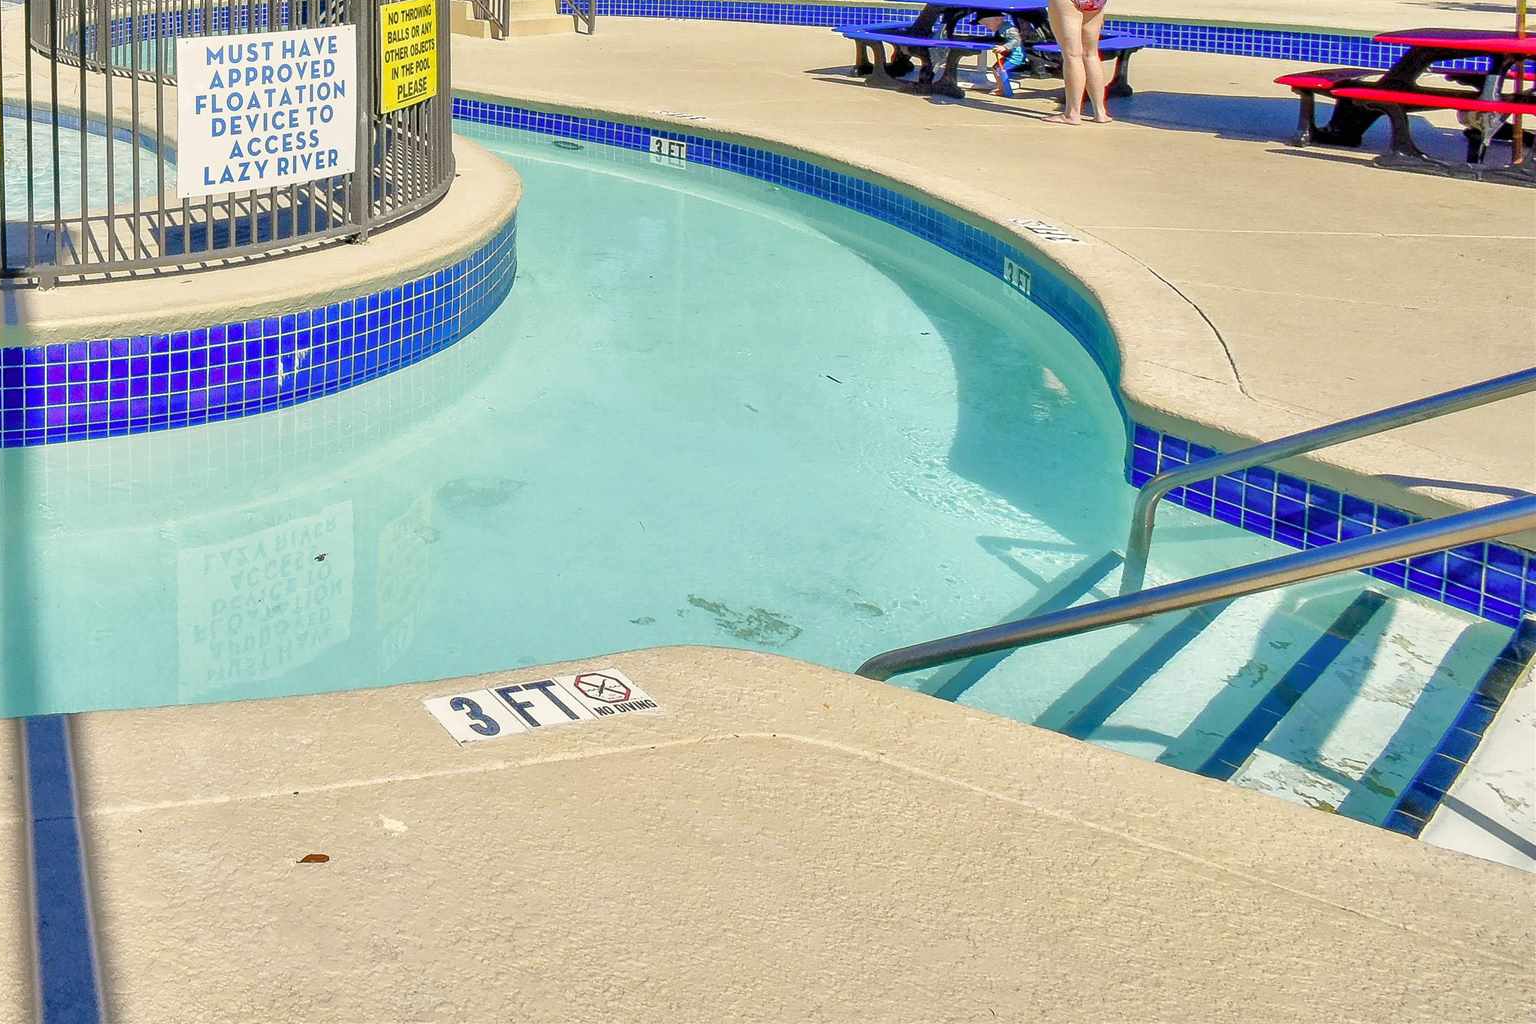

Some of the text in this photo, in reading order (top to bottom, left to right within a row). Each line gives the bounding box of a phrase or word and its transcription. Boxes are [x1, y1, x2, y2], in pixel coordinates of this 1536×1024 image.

[388, 4, 432, 25] NO THROWING
[387, 21, 433, 44] BALLS OR ANY
[206, 35, 338, 65] MUST HAVE
[385, 39, 435, 63] OTHER OBJECTS
[209, 59, 336, 89] APPROVED
[391, 58, 431, 80] IN THE POOL
[195, 80, 346, 115] FLOATATION
[397, 77, 427, 100] PLEASE
[211, 104, 334, 137] DEVICE TO
[229, 129, 320, 159] ACCESS
[655, 139, 685, 160] 3 FT
[204, 149, 339, 186] LAZY RIVER
[449, 679, 658, 736] 3 FT NO DIVING
